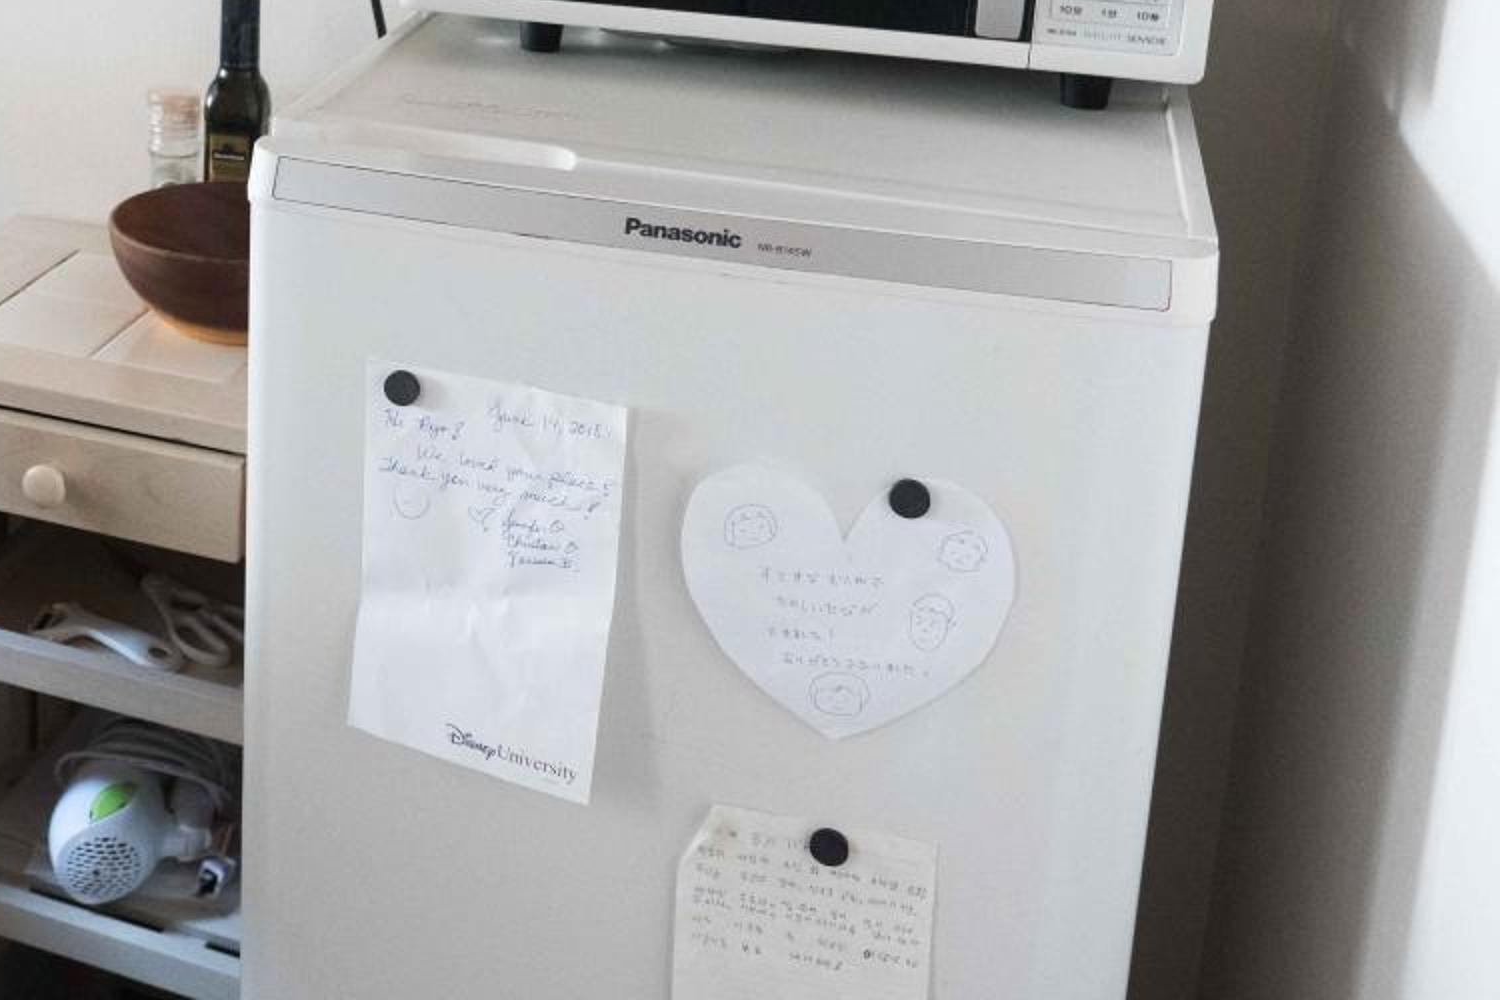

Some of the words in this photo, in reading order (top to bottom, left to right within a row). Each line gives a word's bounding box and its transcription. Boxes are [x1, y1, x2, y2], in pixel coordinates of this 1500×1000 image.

[624, 217, 742, 249] Panasonic
[379, 456, 438, 481] Thank
[440, 470, 470, 490] you
[445, 723, 497, 760] Disney
[497, 745, 577, 785] University
